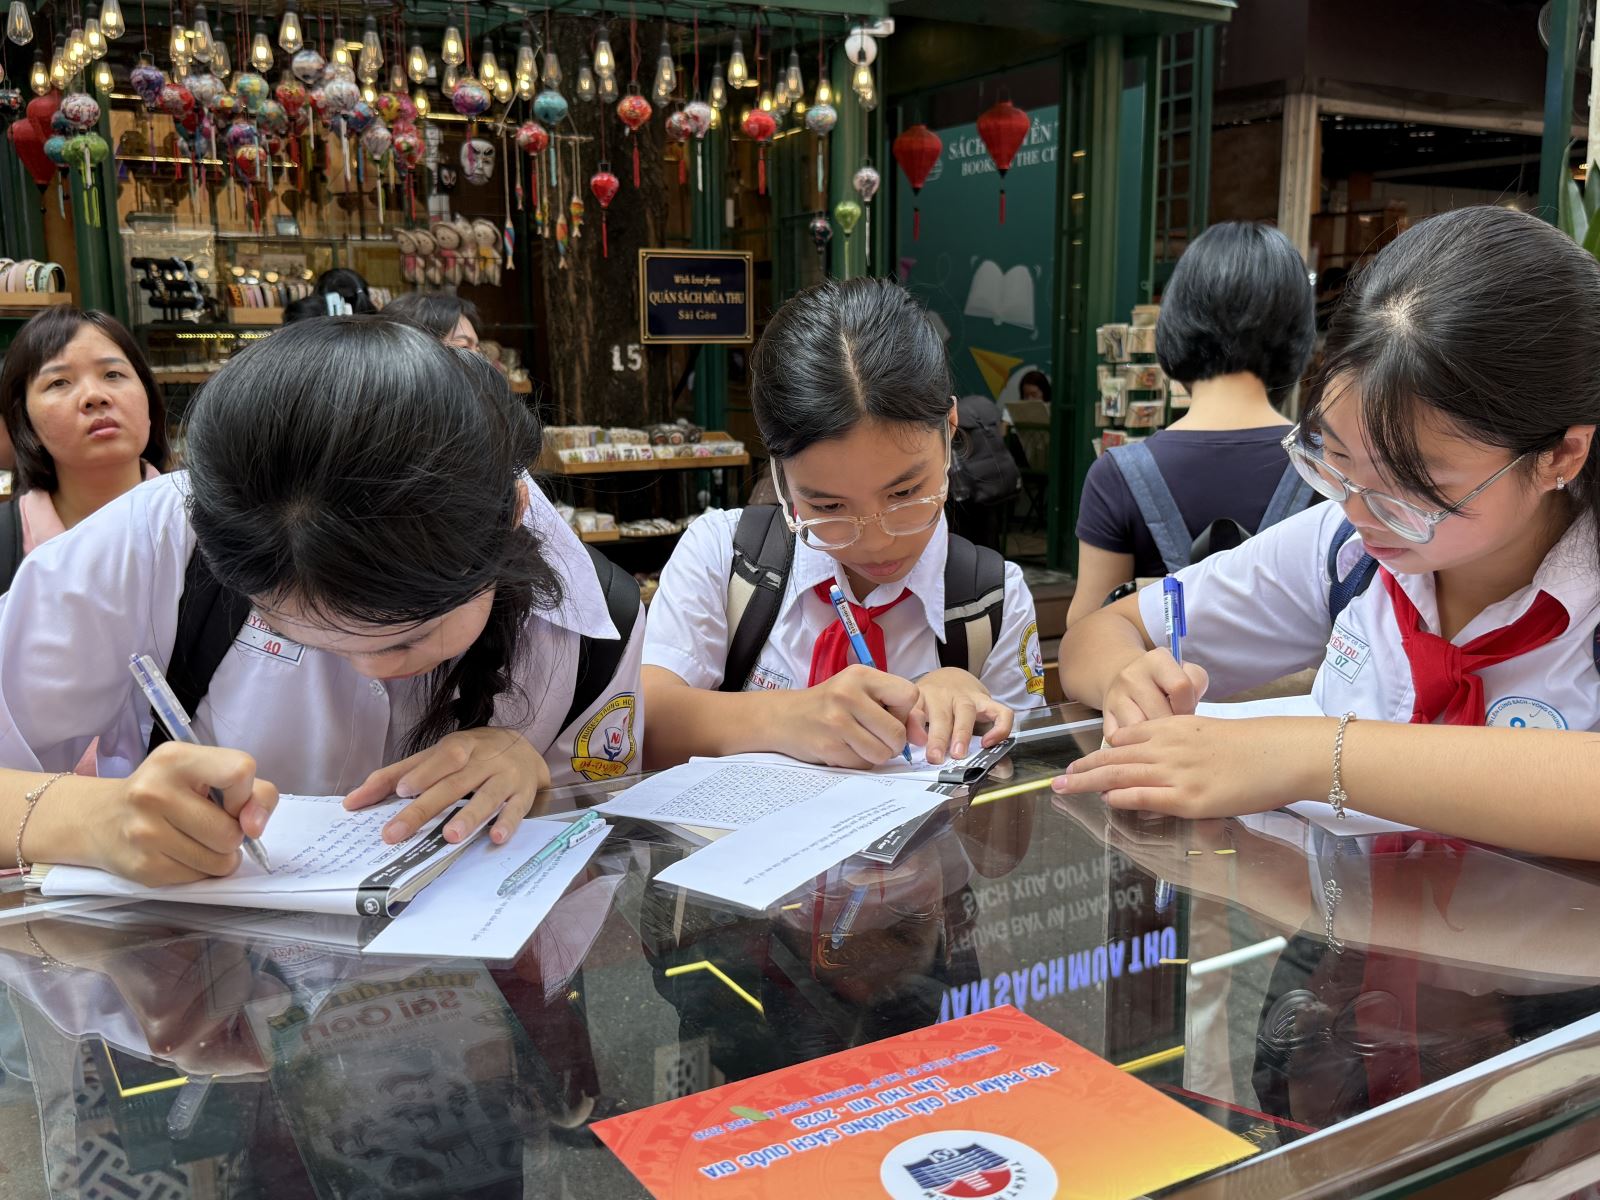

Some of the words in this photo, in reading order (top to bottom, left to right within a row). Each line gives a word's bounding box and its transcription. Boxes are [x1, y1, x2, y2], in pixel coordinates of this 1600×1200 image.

[1016, 149, 1039, 167] THE
[649, 289, 677, 305] QUÁN
[677, 289, 702, 304] SÁCH
[703, 289, 725, 304] MÙA
[725, 292, 744, 304] THU
[678, 310, 694, 320] Sài
[611, 344, 642, 371] 15
[264, 640, 281, 655] 40
[1335, 655, 1349, 668] 07
[1021, 1062, 1059, 1079] TÁC
[910, 1075, 948, 1092] LẦN
[976, 1072, 1025, 1092] PHẨM
[943, 1086, 979, 1104] ĐẠT
[777, 1101, 811, 1115] BOOK
[846, 1097, 879, 1113] VIII
[907, 1096, 944, 1115] GIẢI
[792, 1109, 839, 1129] 2026
[789, 1128, 840, 1147] SÁCH
[738, 1144, 790, 1168] QUỐC
[700, 1160, 738, 1178] GIA
